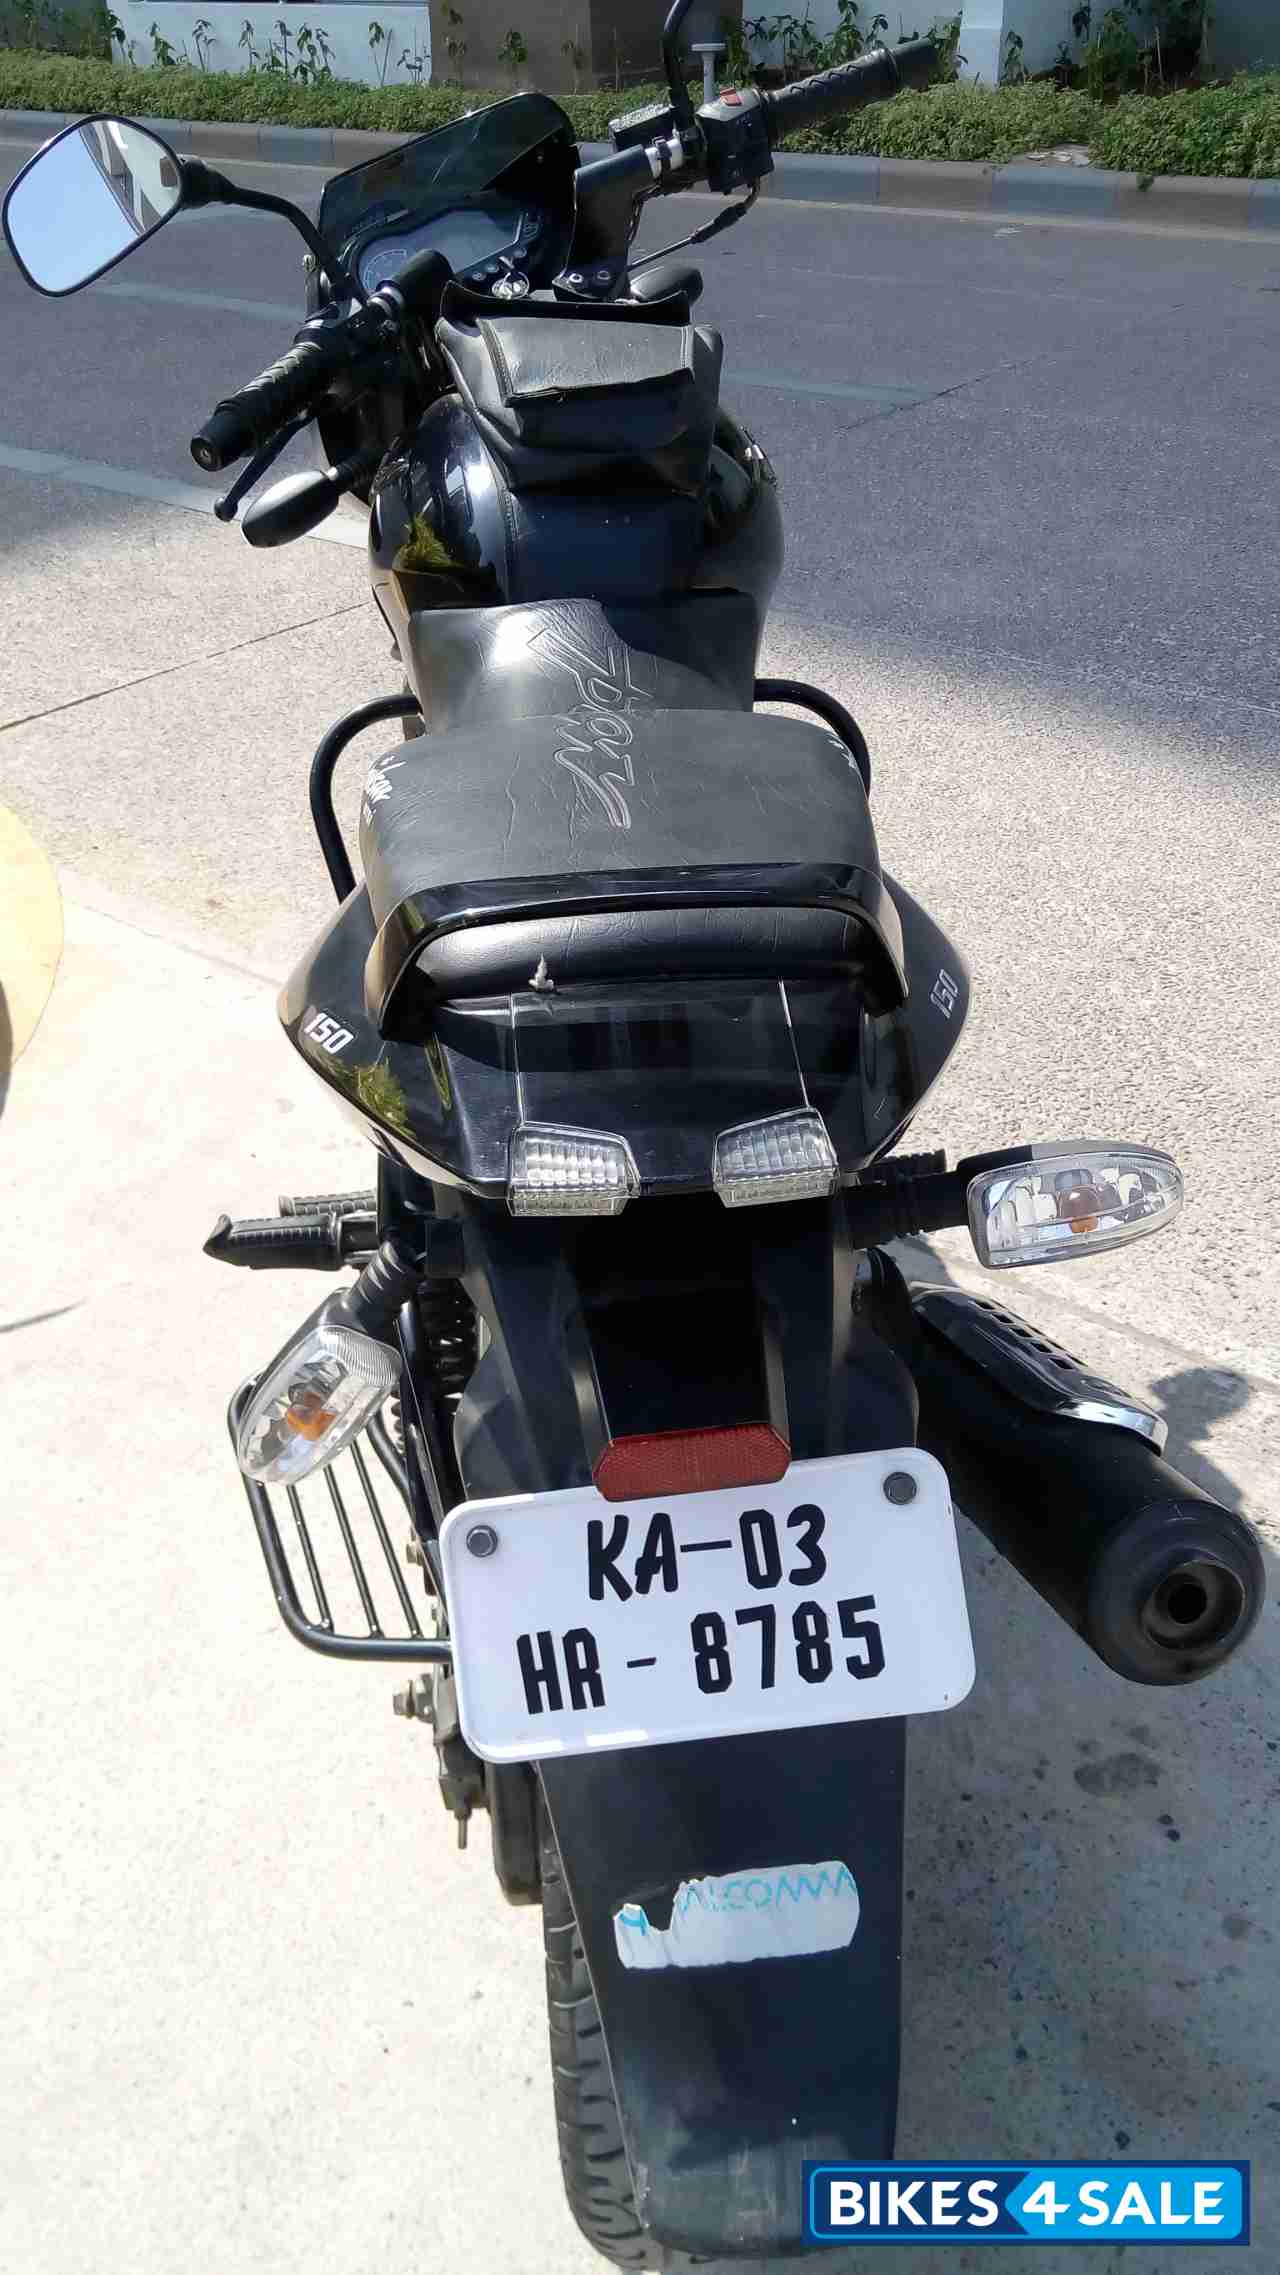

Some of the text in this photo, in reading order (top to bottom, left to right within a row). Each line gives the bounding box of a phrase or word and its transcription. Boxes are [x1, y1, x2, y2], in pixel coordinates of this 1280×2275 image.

[930, 968, 958, 1018] 150
[304, 1012, 354, 1054] 150
[516, 1627, 606, 1715] HR
[690, 1594, 886, 1695] 8785
